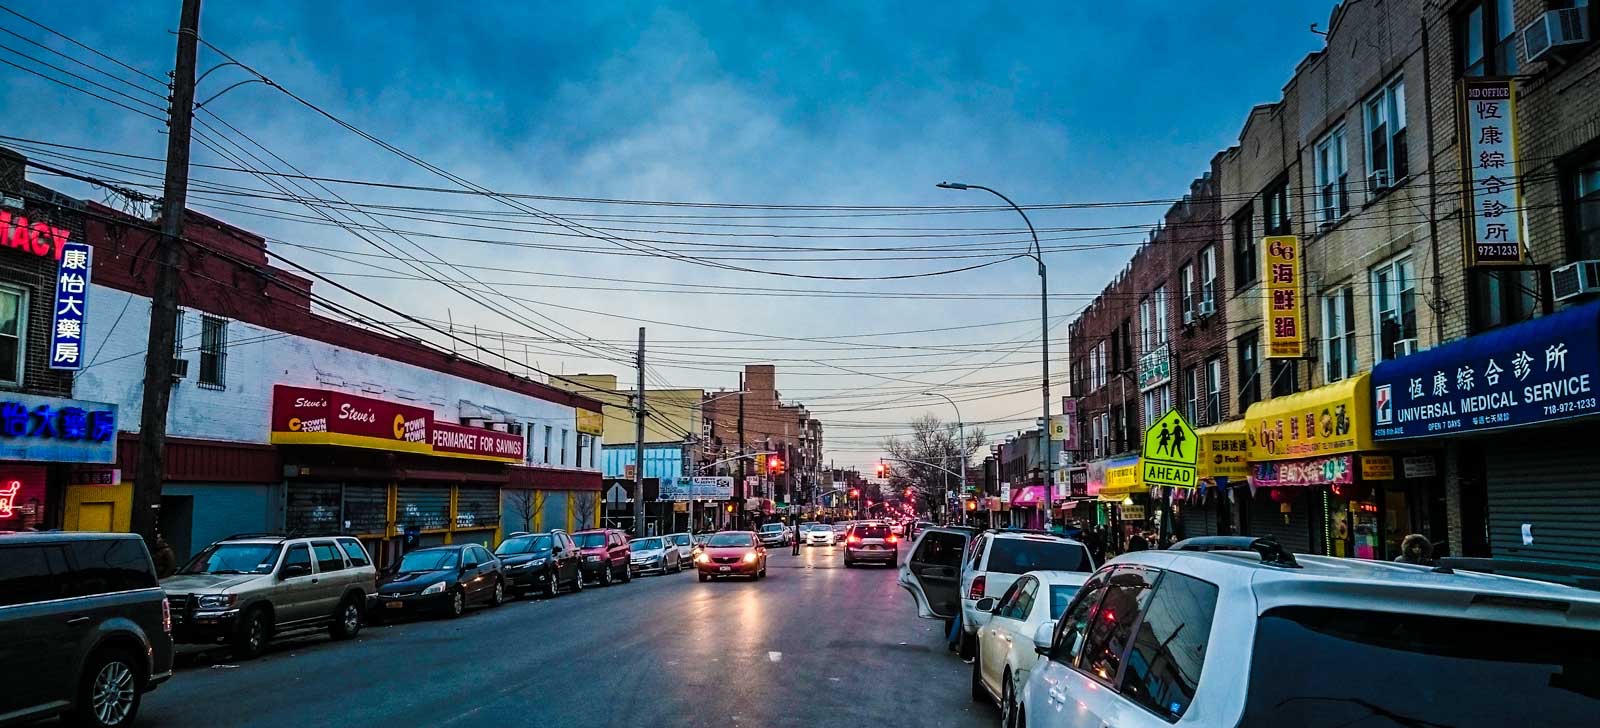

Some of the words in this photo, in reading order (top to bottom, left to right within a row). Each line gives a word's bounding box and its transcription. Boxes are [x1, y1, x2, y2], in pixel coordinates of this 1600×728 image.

[1482, 87, 1509, 98] OFFICE
[1269, 241, 1294, 260] 66
[1478, 245, 1518, 257] 972-1233
[54, 249, 87, 363] 康怡大藥房
[1272, 263, 1296, 338] 海鮮鍋
[295, 397, 328, 408] Steve's
[1397, 400, 1456, 423] UNIVERSAL
[1460, 390, 1518, 414] MEDICAL
[1523, 373, 1590, 404] SERVICE
[1543, 398, 1596, 416] 718-972-1233
[338, 403, 376, 423] Steve's
[289, 418, 301, 431] C
[301, 417, 326, 428] TOWN
[394, 414, 405, 439] C
[404, 417, 425, 432] TOWN
[1428, 422, 1441, 431] OPEN
[1447, 420, 1461, 429] DAYS
[432, 430, 477, 450] PERMARKET
[480, 435, 494, 452] FOR
[496, 438, 522, 456] SAVINGS
[1148, 466, 1190, 482] AHEAD
